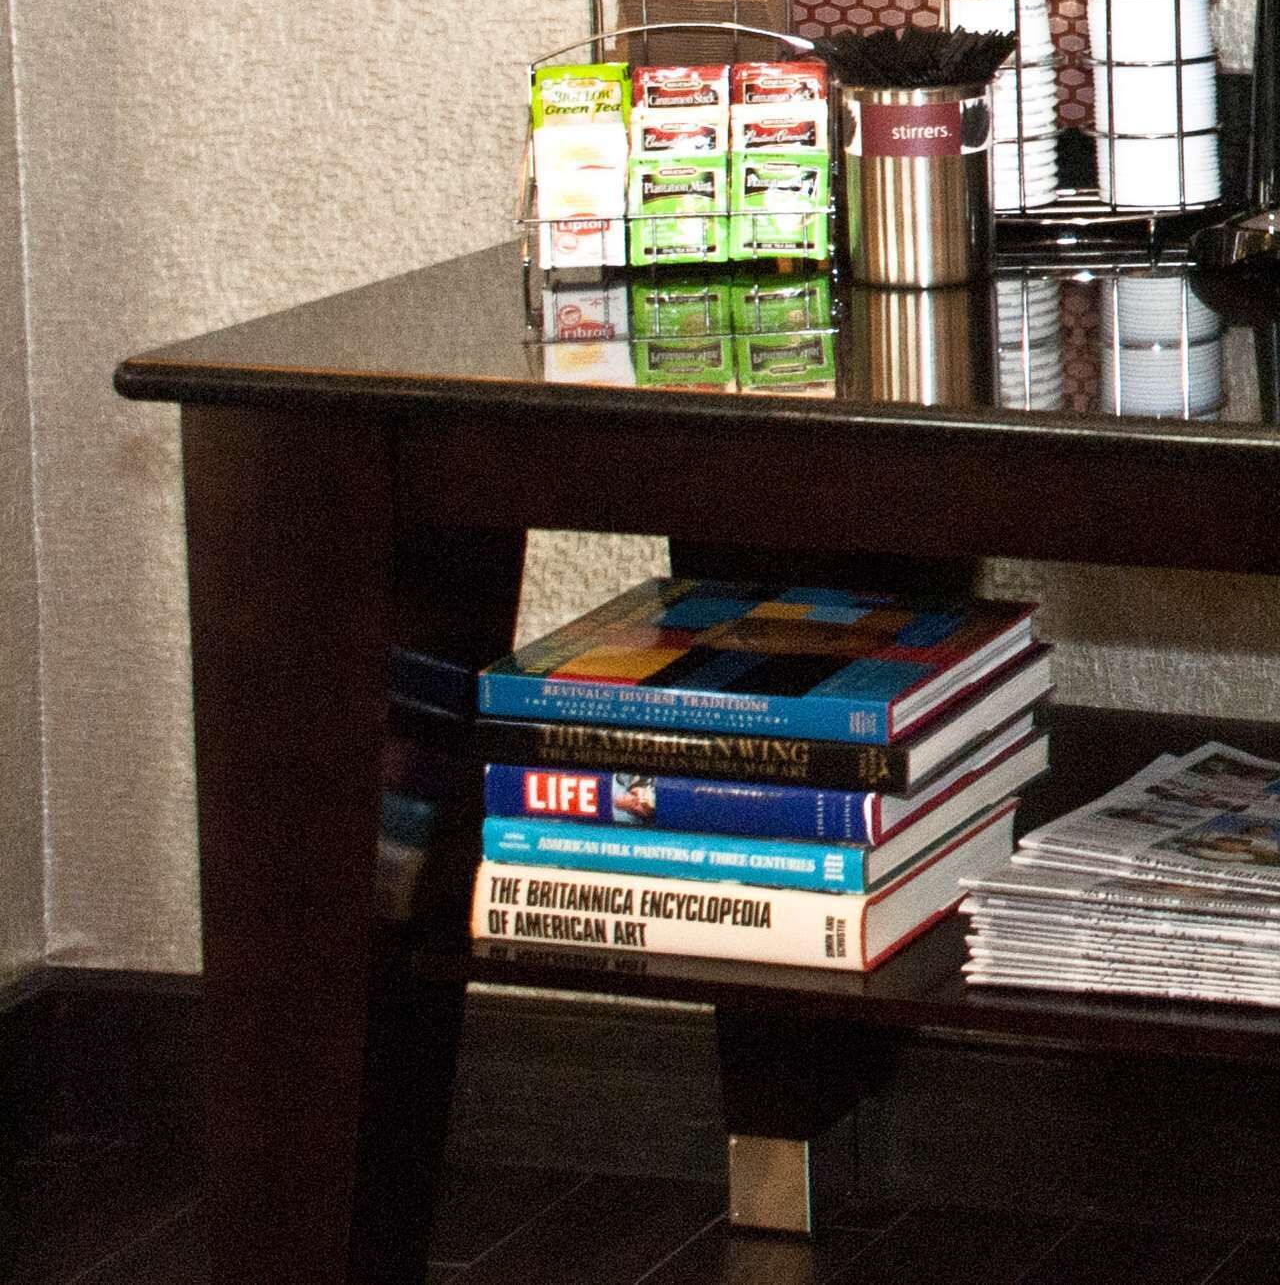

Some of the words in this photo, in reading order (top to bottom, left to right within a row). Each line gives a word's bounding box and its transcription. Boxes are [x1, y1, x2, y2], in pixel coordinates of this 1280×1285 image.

[544, 103, 589, 115] Green
[595, 101, 621, 113] Tea
[891, 124, 953, 140] stirrers.
[644, 182, 688, 193] Plantation
[619, 691, 675, 705] DIVERSE
[682, 695, 769, 711] TRADITIONS
[737, 737, 810, 763] WING
[528, 775, 598, 813] LIFE
[538, 837, 598, 854] AMERICAN
[601, 842, 631, 857] FOLK
[489, 876, 522, 905] THE
[526, 879, 633, 915] BRITANNICA
[640, 889, 771, 929] ENCYCLOPEDIA
[489, 909, 509, 935] OF
[514, 911, 607, 943] AMERICAN
[614, 920, 647, 947] ART
